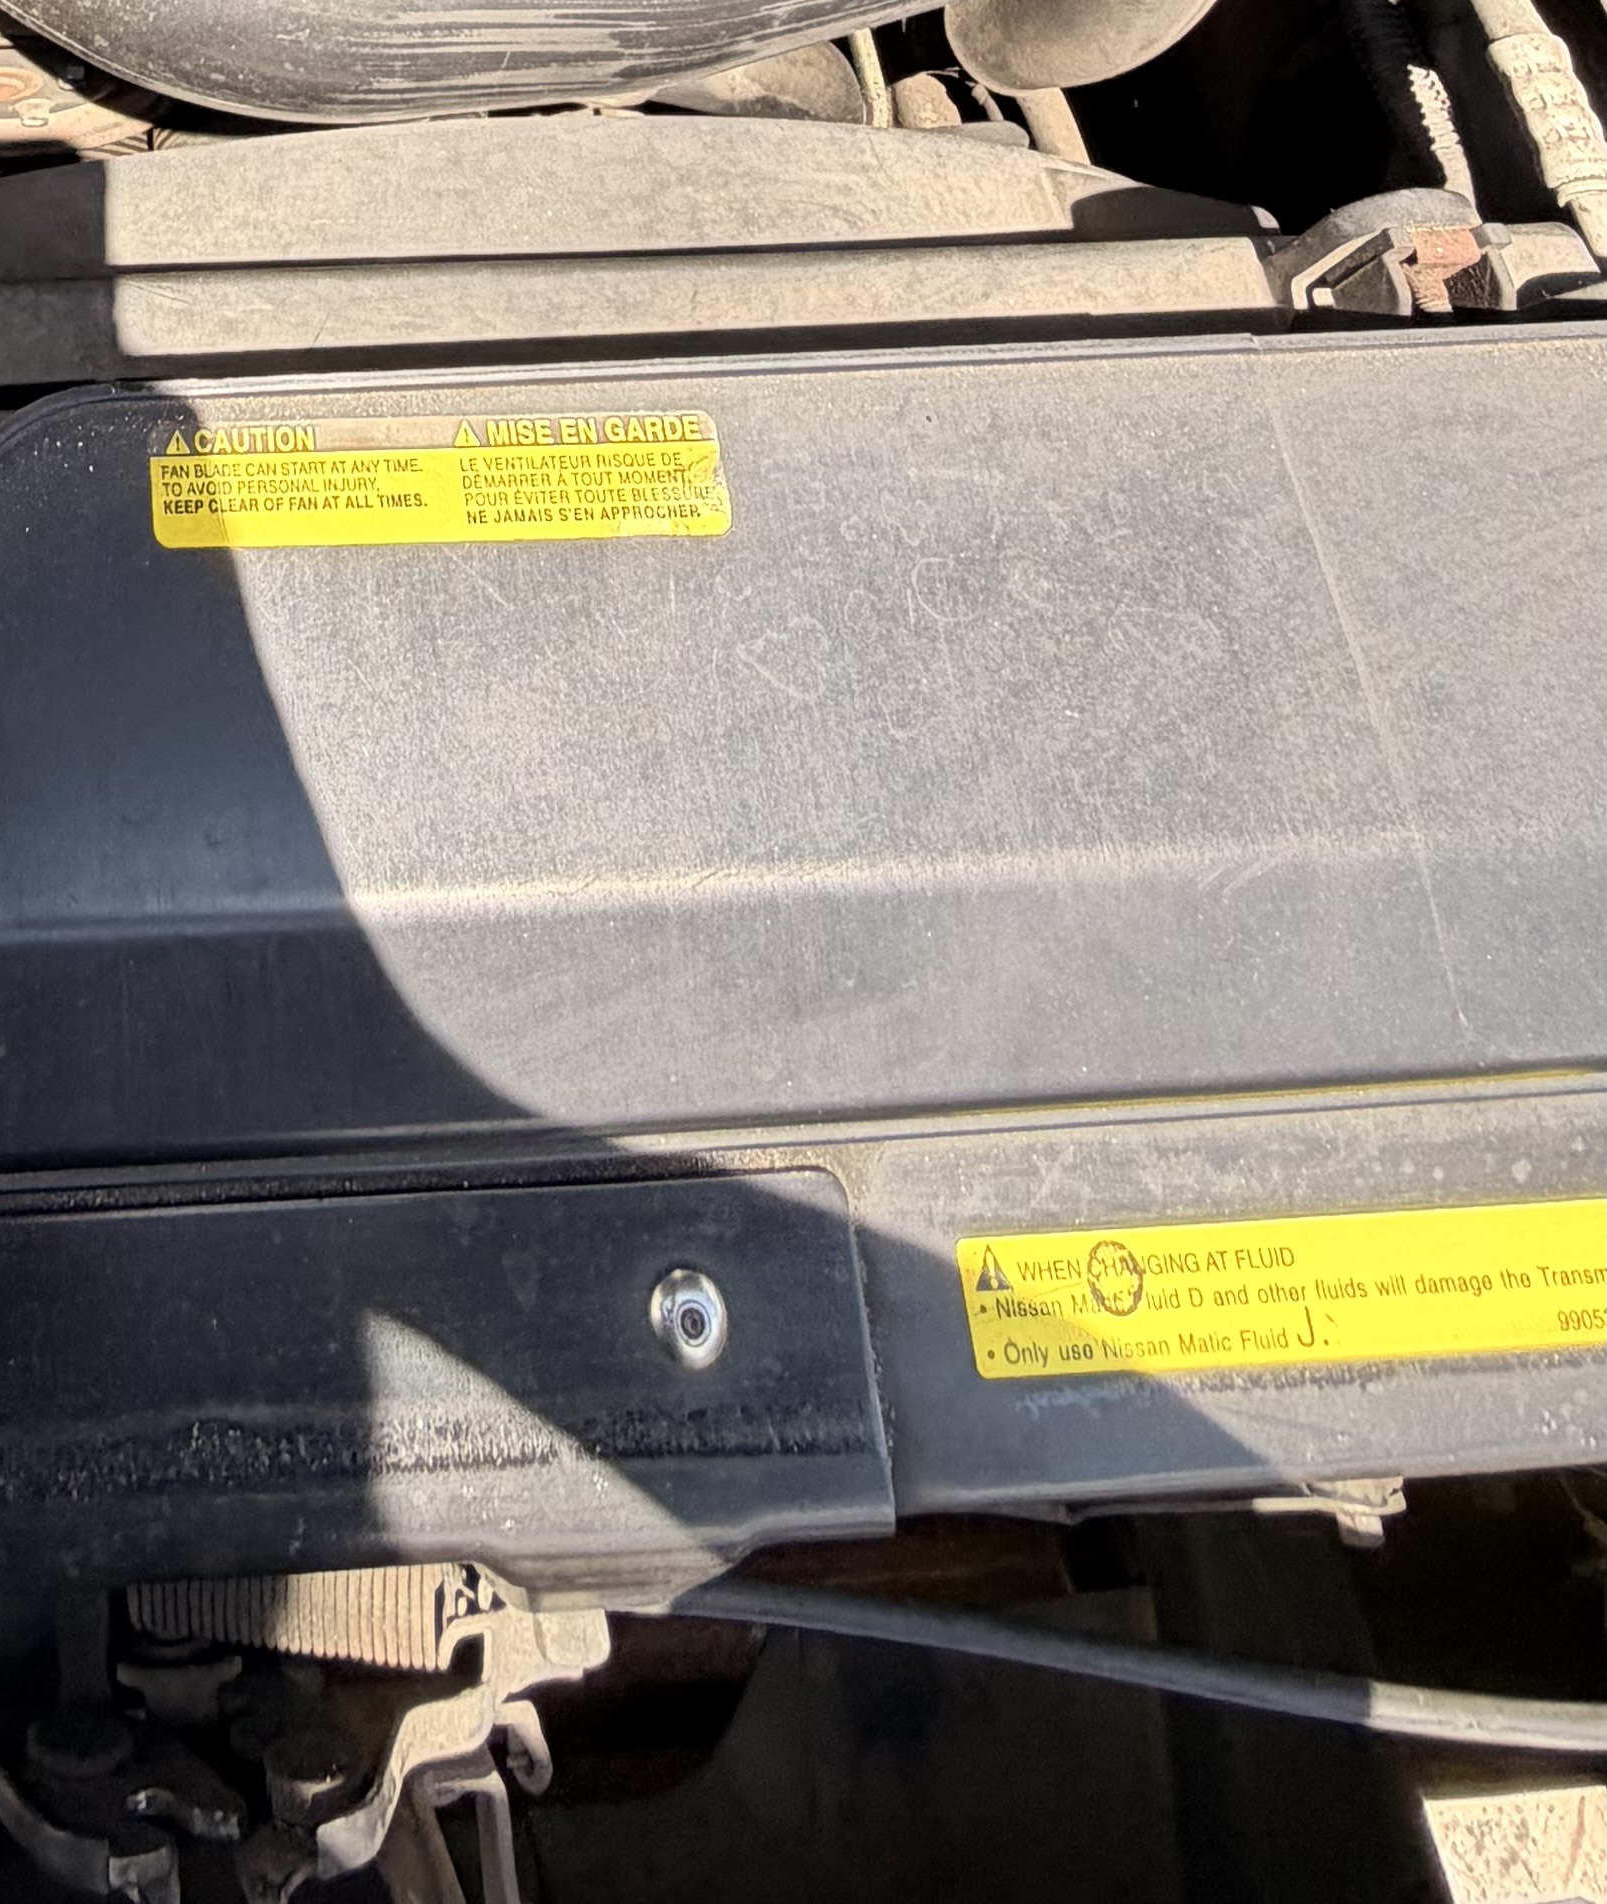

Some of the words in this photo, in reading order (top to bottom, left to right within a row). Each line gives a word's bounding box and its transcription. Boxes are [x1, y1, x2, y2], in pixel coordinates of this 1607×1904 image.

[194, 426, 316, 453] CAUTION
[486, 418, 555, 446] MISE
[559, 417, 598, 444] EN
[604, 415, 703, 442] GARDE
[161, 464, 191, 481] FAN
[194, 462, 242, 479] BLADE
[245, 461, 277, 477] CAN
[282, 460, 326, 476] START
[331, 459, 346, 474] AT
[350, 459, 380, 474] ANY
[460, 456, 478, 472] LE
[482, 454, 592, 471] VENTILATEUR
[596, 452, 657, 469] RISQUE
[661, 452, 683, 467] DE
[162, 482, 183, 498] TO
[187, 480, 232, 496] AVOID
[237, 478, 319, 495] PERSONAL
[462, 472, 551, 490] DÉMARRER
[570, 470, 613, 486] TOUT
[163, 499, 204, 515] KEEP
[208, 497, 260, 513] CLEAR
[264, 496, 284, 512] OF
[289, 495, 318, 511] FAN
[322, 494, 340, 510] AT
[345, 494, 374, 509] ALL
[377, 493, 428, 509] TIMES.
[464, 491, 509, 507] POUR
[513, 487, 571, 505] ÉVITER
[576, 488, 627, 504] TOUTE
[467, 510, 488, 525] NE
[493, 507, 553, 523] JAMAIS
[558, 506, 594, 522] S'EN
[1016, 1258, 1082, 1281] WHEN
[1088, 1251, 1200, 1280] CHANGING
[1205, 1250, 1228, 1272] AT
[1235, 1246, 1295, 1269] FLUID
[995, 1294, 1062, 1319] Nissan
[1128, 1287, 1181, 1311] luid
[1190, 1288, 1205, 1308] D
[1213, 1283, 1249, 1306] and
[1257, 1283, 1307, 1304] other
[1315, 1277, 1368, 1302] fluids
[1375, 1273, 1407, 1297] will
[1415, 1273, 1493, 1297] damage
[1500, 1268, 1532, 1290] the
[1557, 1308, 1607, 1331] 9905
[1003, 1340, 1049, 1368] Only
[1059, 1340, 1094, 1361] use
[1103, 1336, 1171, 1361] Nissan
[1178, 1331, 1232, 1355] Matic
[1240, 1326, 1289, 1351] Fluid
